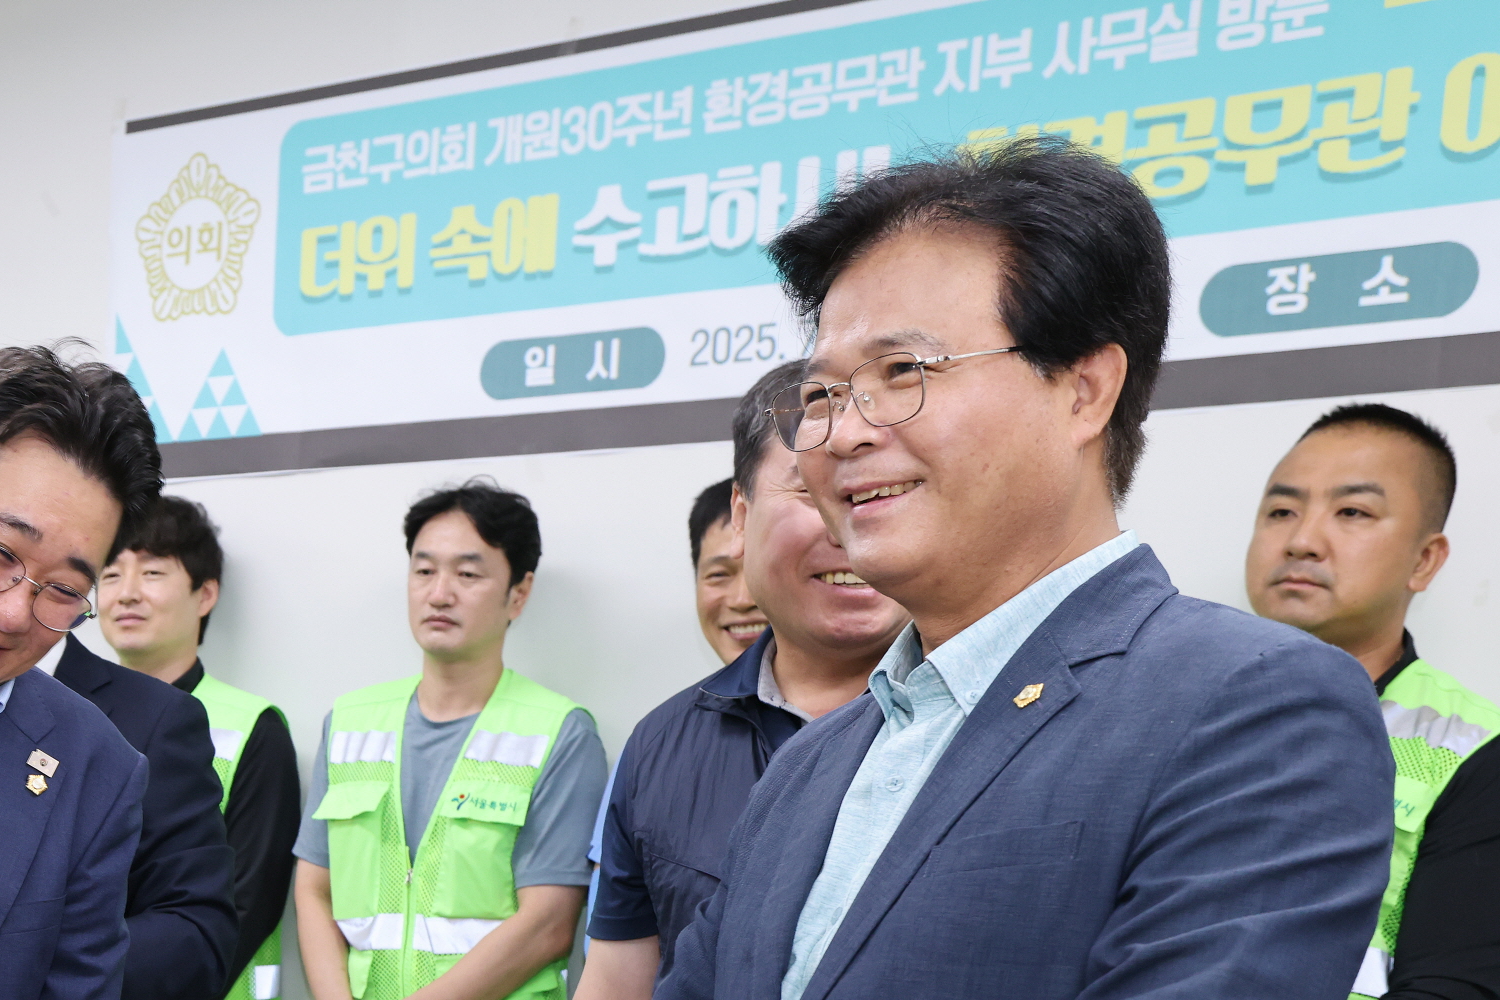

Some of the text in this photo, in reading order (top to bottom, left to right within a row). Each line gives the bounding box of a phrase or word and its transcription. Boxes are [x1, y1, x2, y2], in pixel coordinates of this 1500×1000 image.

[301, 122, 476, 194] 금천구의회
[484, 84, 694, 166] 개원30주년
[703, 47, 925, 134] 환경공무관
[933, 27, 1032, 96] 지부
[1042, 0, 1202, 79] 사무실
[166, 220, 224, 266] 의회
[298, 211, 418, 298] 더위
[428, 192, 560, 282] 속에
[690, 322, 786, 367] 2025.
